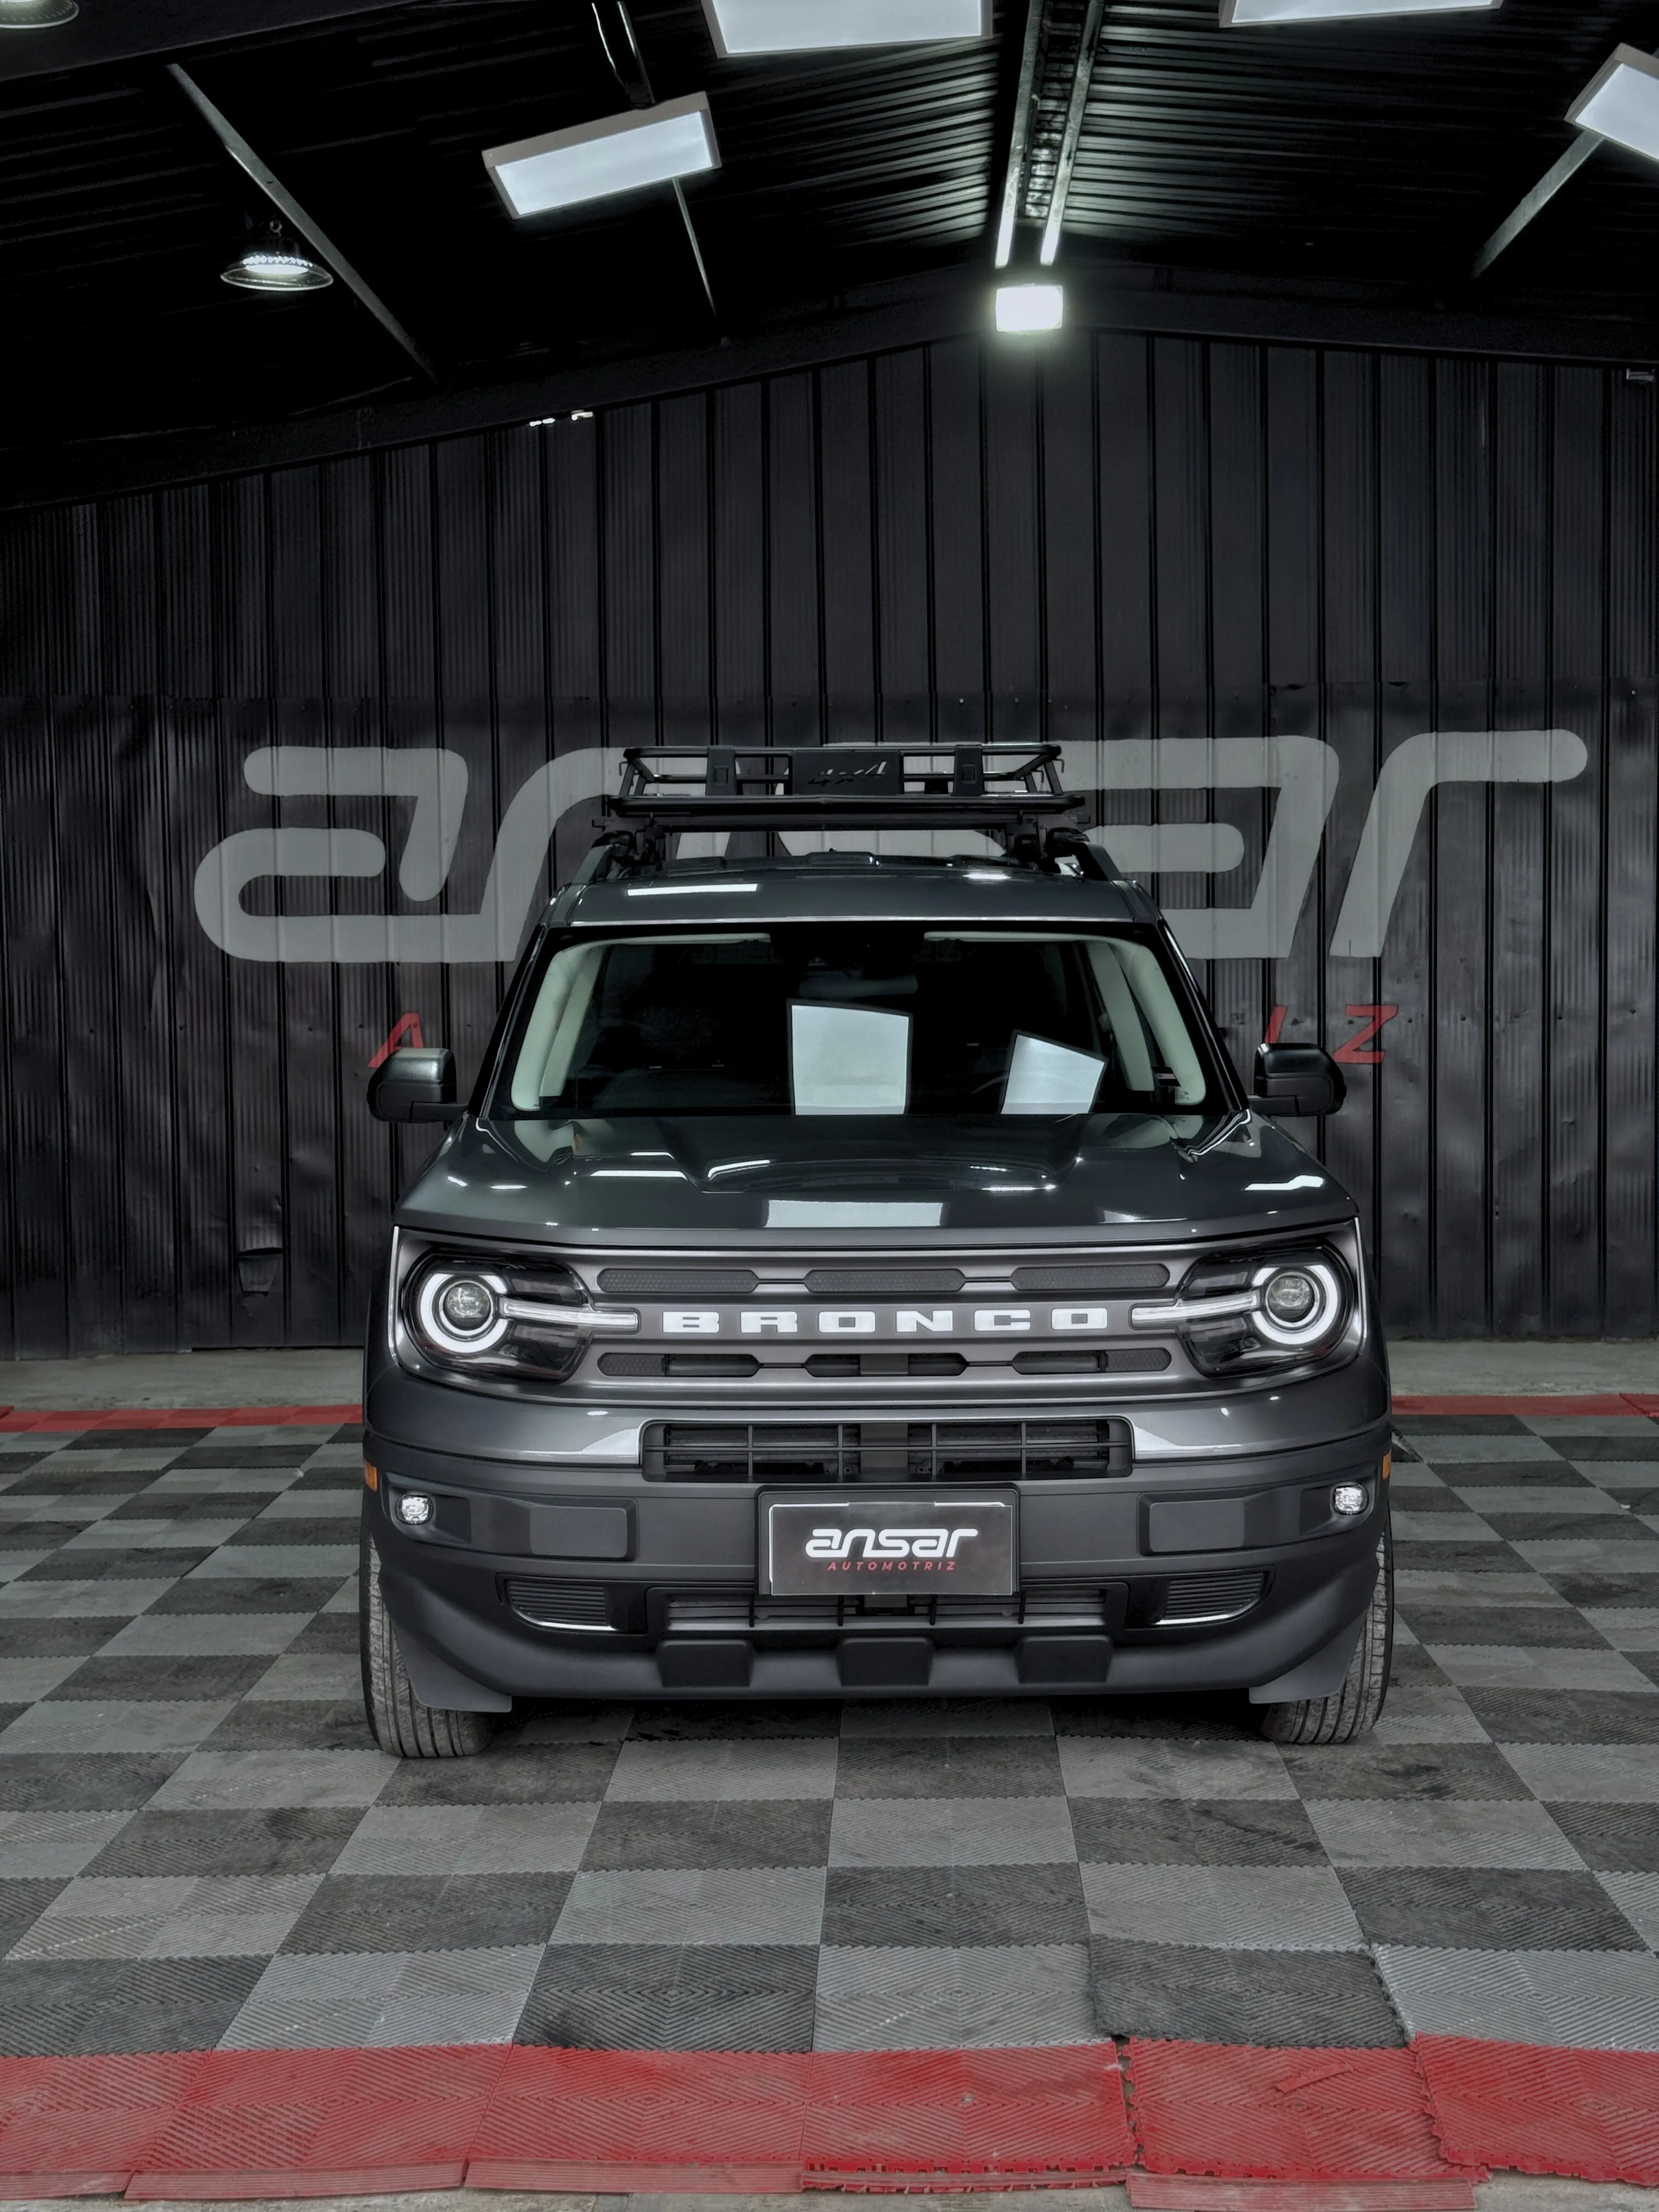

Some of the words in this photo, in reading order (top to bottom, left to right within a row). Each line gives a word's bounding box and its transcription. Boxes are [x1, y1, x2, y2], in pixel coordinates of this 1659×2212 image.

[662, 1307, 1108, 1334] BRONCO
[805, 1528, 979, 1559] ansar
[827, 1560, 956, 1572] AUTOMOTRIZ
